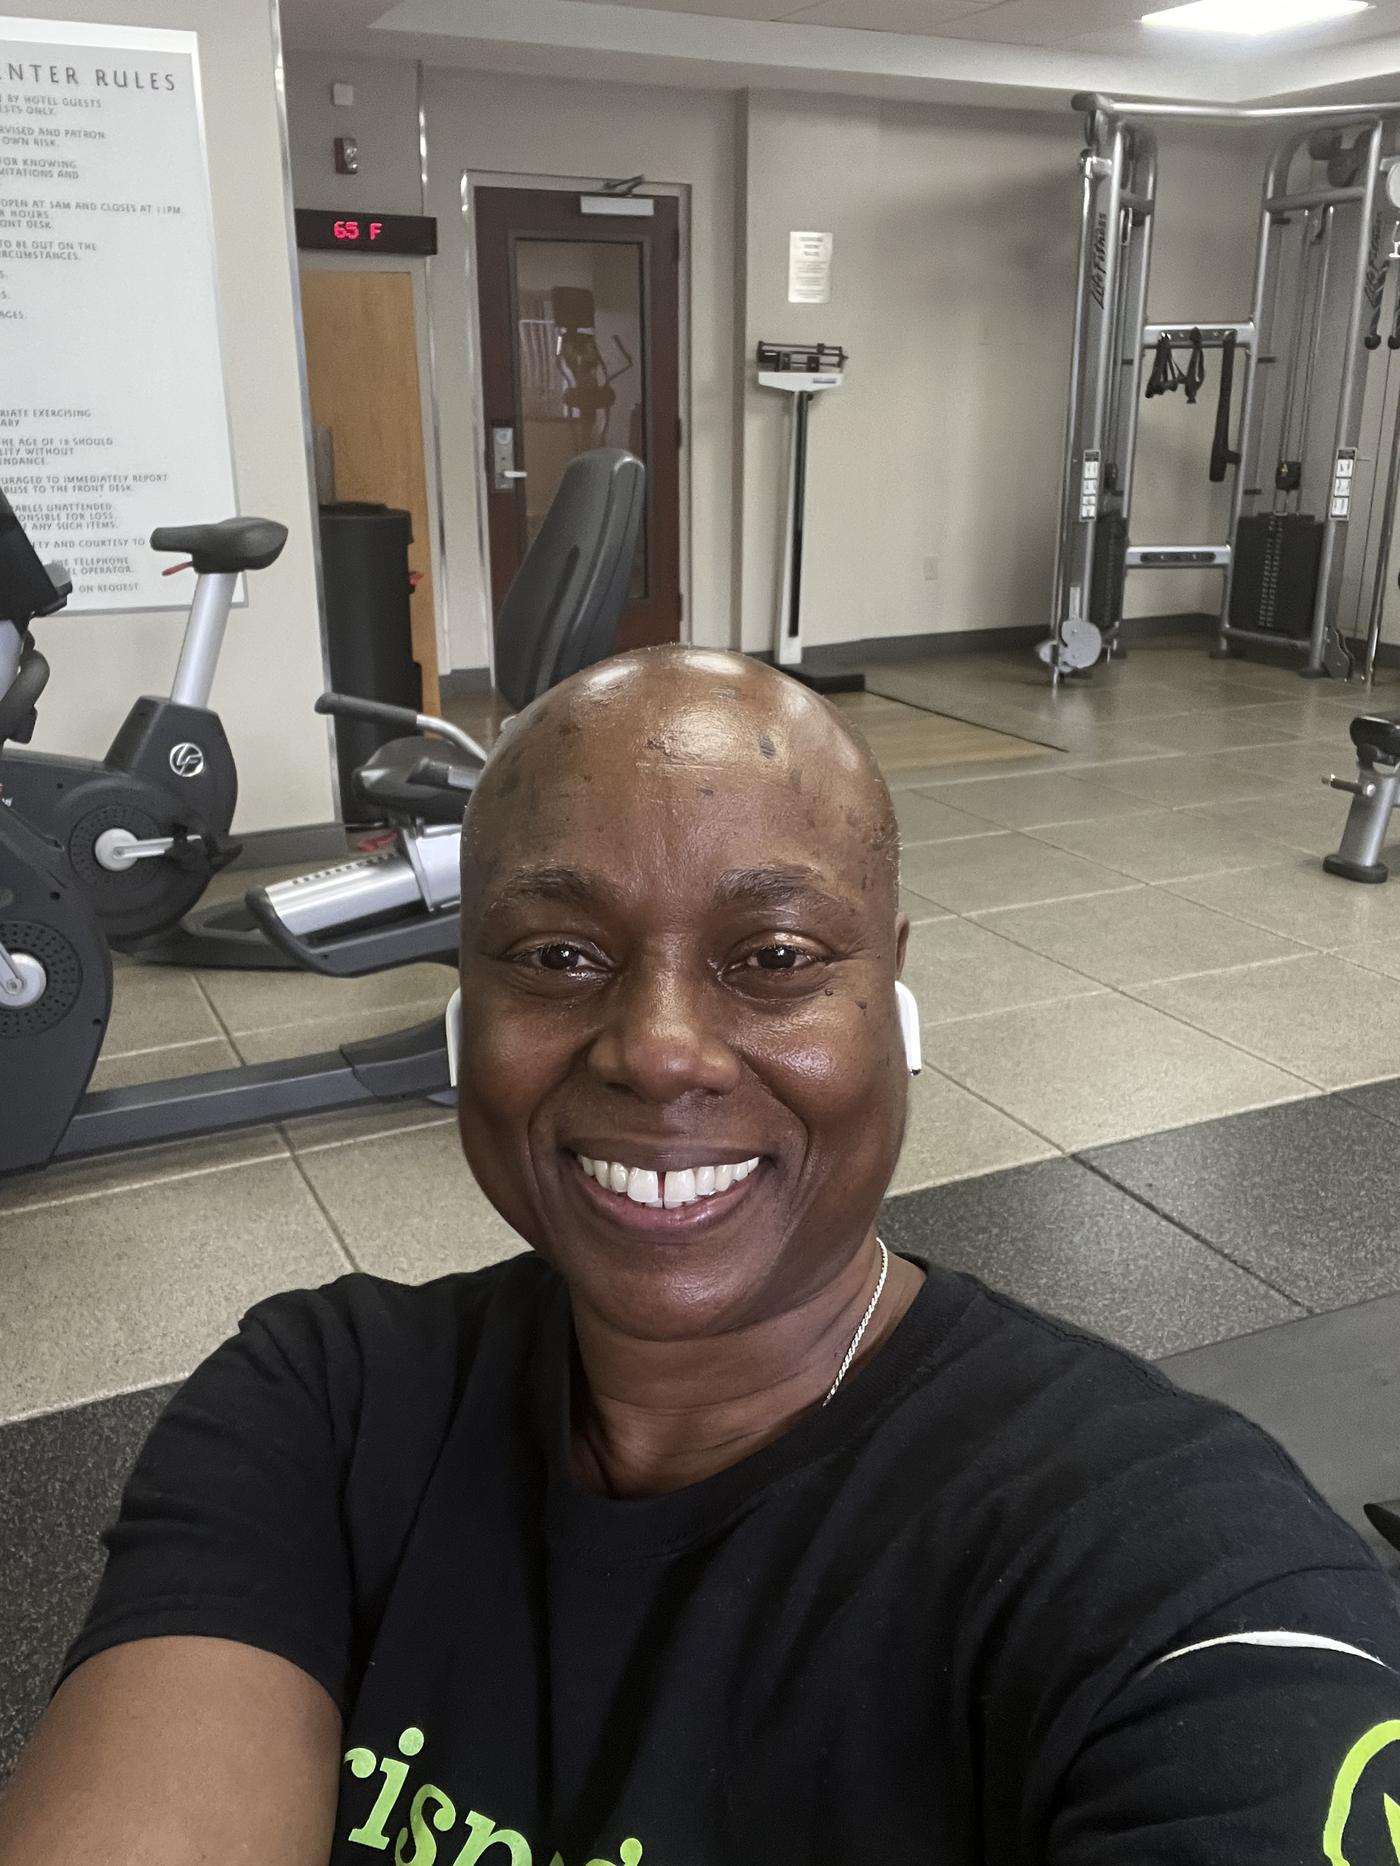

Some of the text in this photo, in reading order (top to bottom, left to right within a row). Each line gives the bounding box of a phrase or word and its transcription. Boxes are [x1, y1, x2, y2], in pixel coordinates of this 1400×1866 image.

[0, 63, 175, 91] NTER RULES
[8, 94, 19, 103] BY
[24, 95, 57, 106] HOTEL
[62, 97, 102, 108] GUESTS
[38, 127, 60, 137] AND
[23, 158, 77, 169] KNOWING
[57, 169, 80, 179] AND
[1, 198, 28, 208] OPEN
[32, 199, 46, 209] AT
[75, 202, 97, 211] AND
[100, 203, 136, 213] CLOSES
[140, 204, 152, 214] AT
[333, 221, 383, 240] 65 F
[16, 240, 27, 249] BE
[31, 241, 53, 250] OUT
[58, 242, 74, 251] ON
[78, 242, 97, 252] THE
[32, 408, 92, 418] EXERCISING
[18, 438, 38, 446] AGE
[41, 438, 54, 446] OF
[73, 437, 113, 446] SHOULD
[25, 447, 74, 456] WITHOUT
[46, 475, 60, 485] TO
[63, 474, 128, 484] IMMEDIATELY
[132, 473, 168, 483] REPORT
[33, 485, 46, 494] TO
[51, 485, 68, 494] THE
[72, 484, 105, 494] FRONT
[47, 502, 112, 512] UNATTENDED
[66, 512, 85, 522] FOR
[32, 523, 52, 531] ANY
[57, 522, 82, 531] SUCH
[54, 540, 75, 549] AND
[79, 538, 128, 548] COURTESY
[133, 537, 146, 547] TO
[74, 557, 129, 567] TELEPHONE
[78, 584, 94, 593] ON
